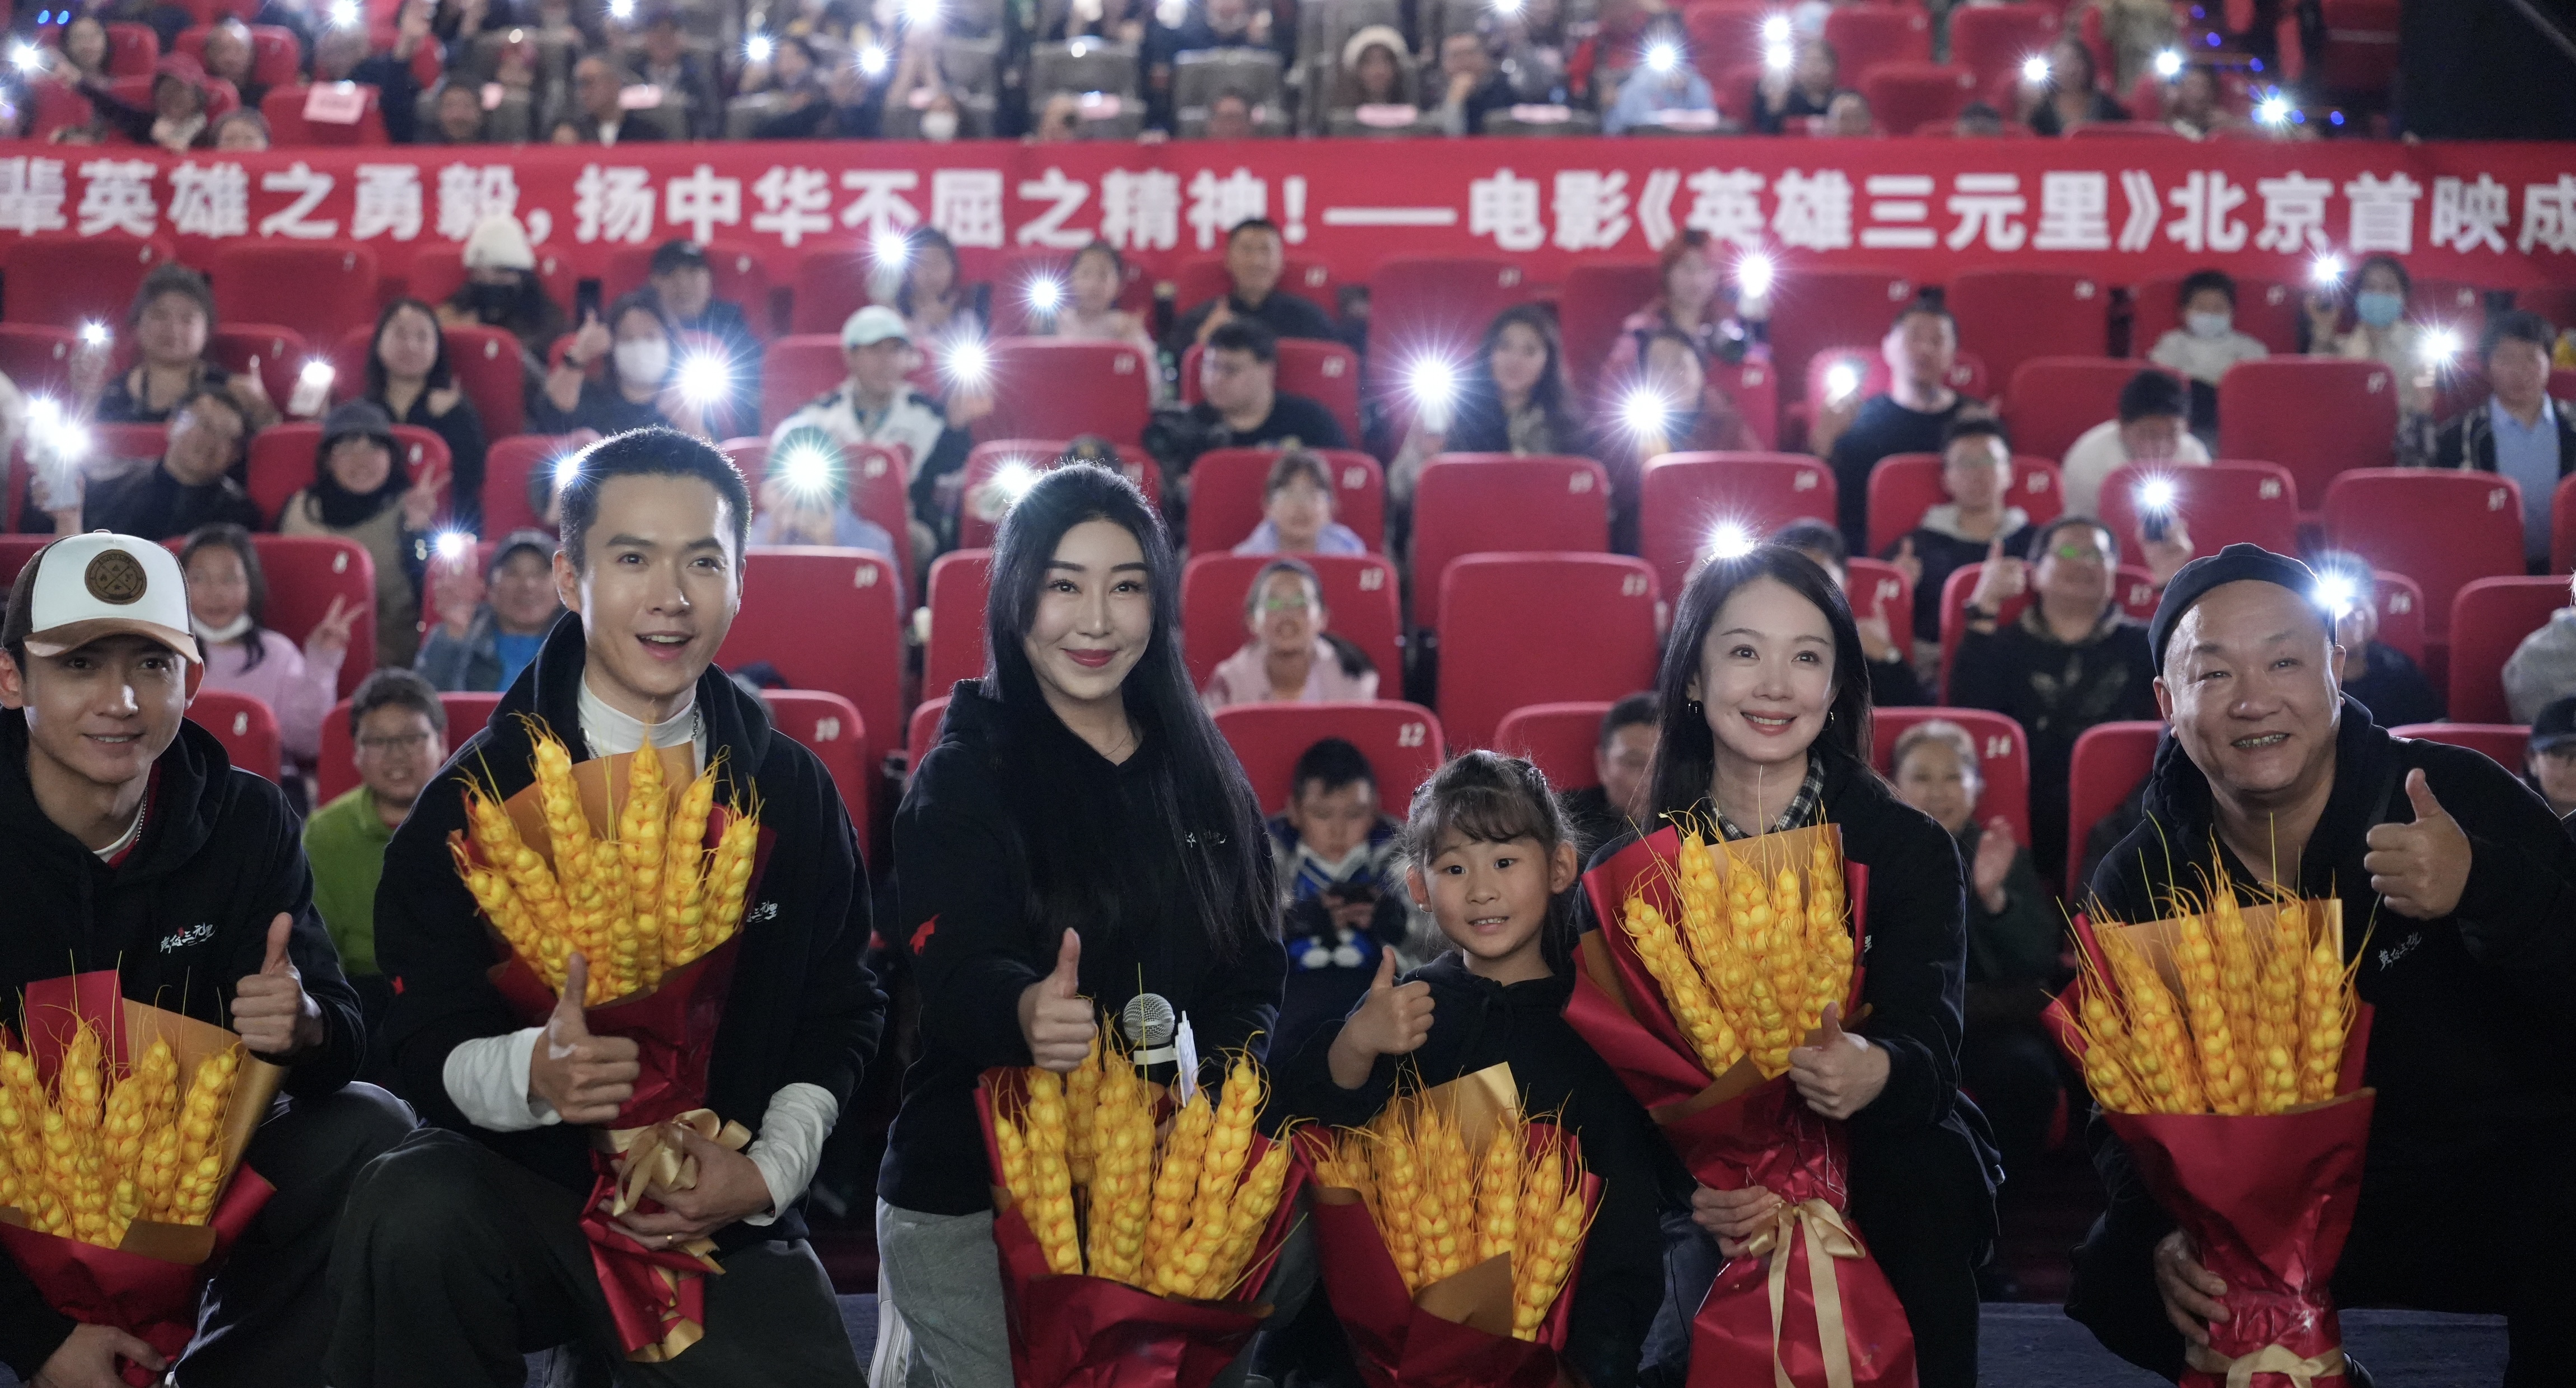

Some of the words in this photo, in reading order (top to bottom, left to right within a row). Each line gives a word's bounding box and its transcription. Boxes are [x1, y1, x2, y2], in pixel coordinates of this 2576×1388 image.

[816, 718, 840, 741] 10
[1399, 723, 1425, 746] 12
[1986, 736, 2011, 758] 14
